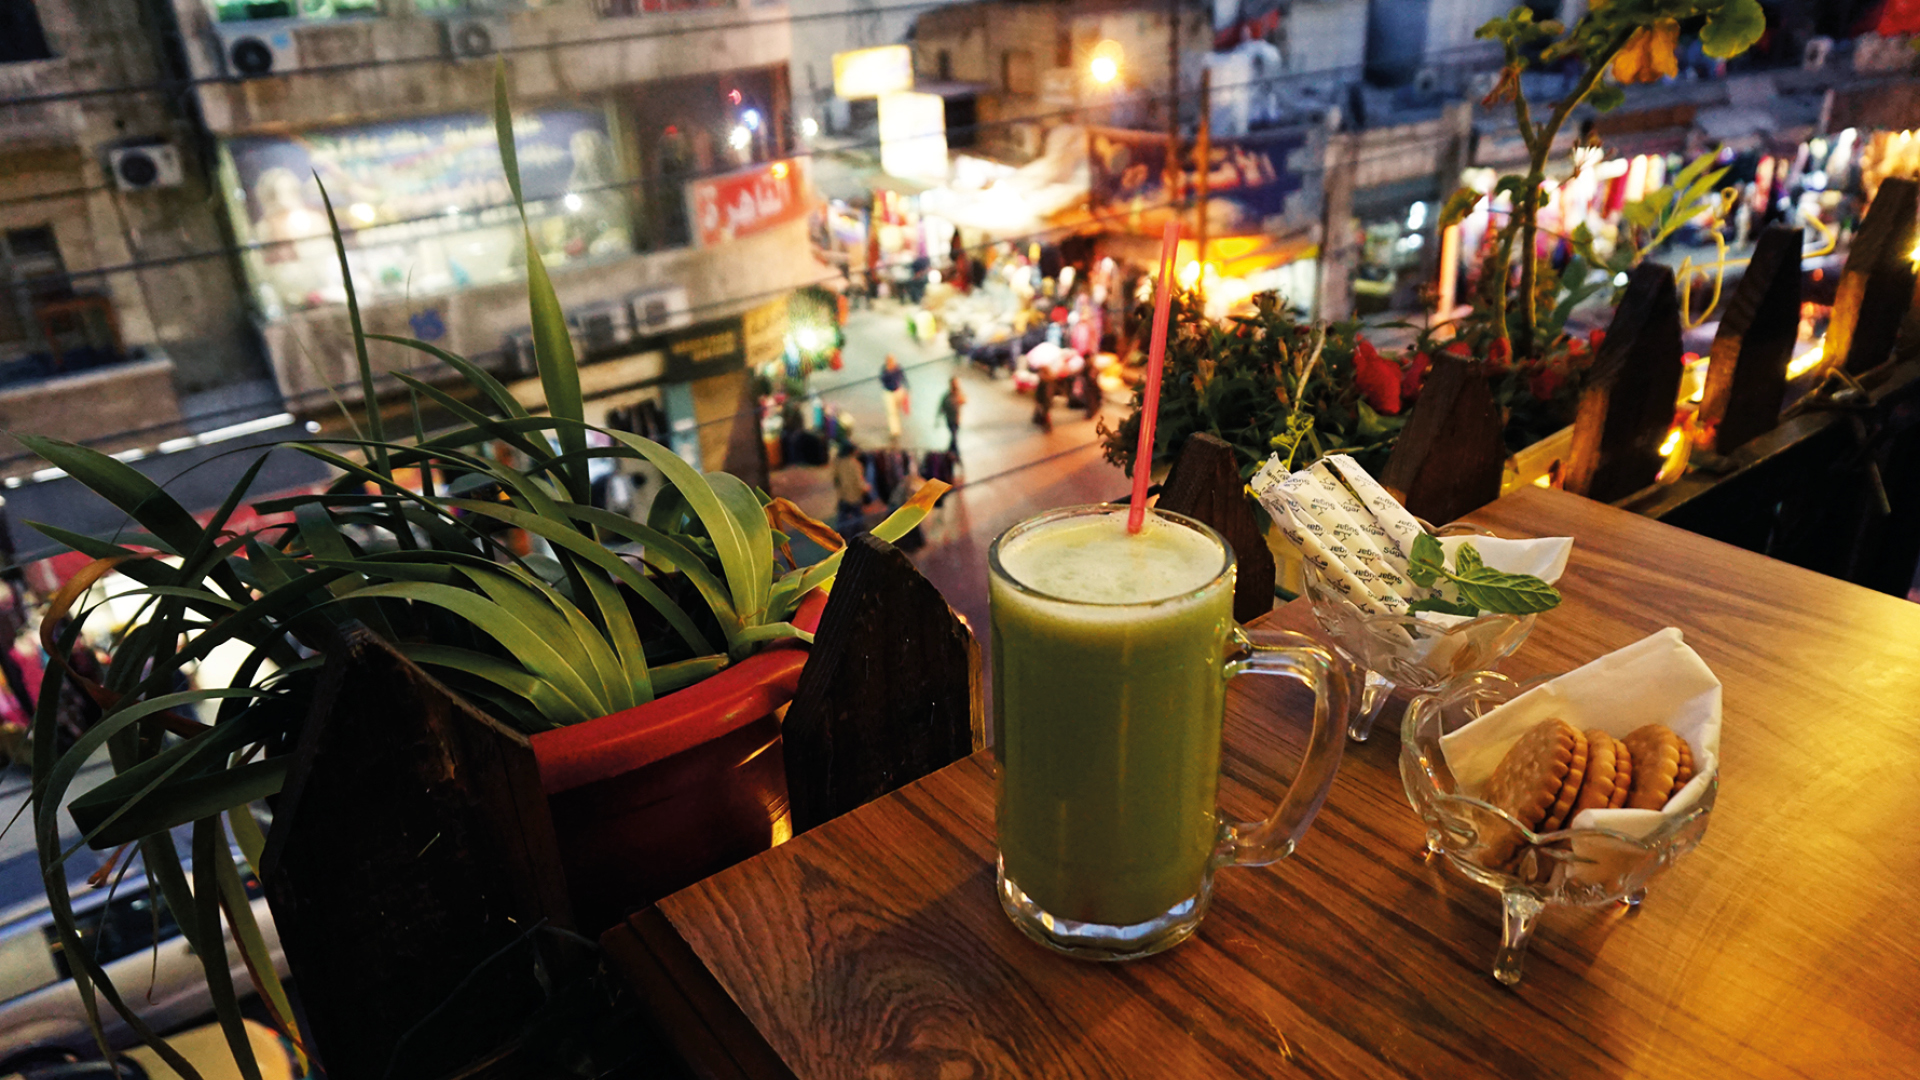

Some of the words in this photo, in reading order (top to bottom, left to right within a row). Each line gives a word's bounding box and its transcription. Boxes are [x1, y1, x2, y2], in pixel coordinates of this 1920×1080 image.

[1335, 523, 1359, 536] Sugar
[1360, 524, 1385, 536] Sugar
[1383, 547, 1400, 558] Sug
[1378, 572, 1402, 584] Sugar
